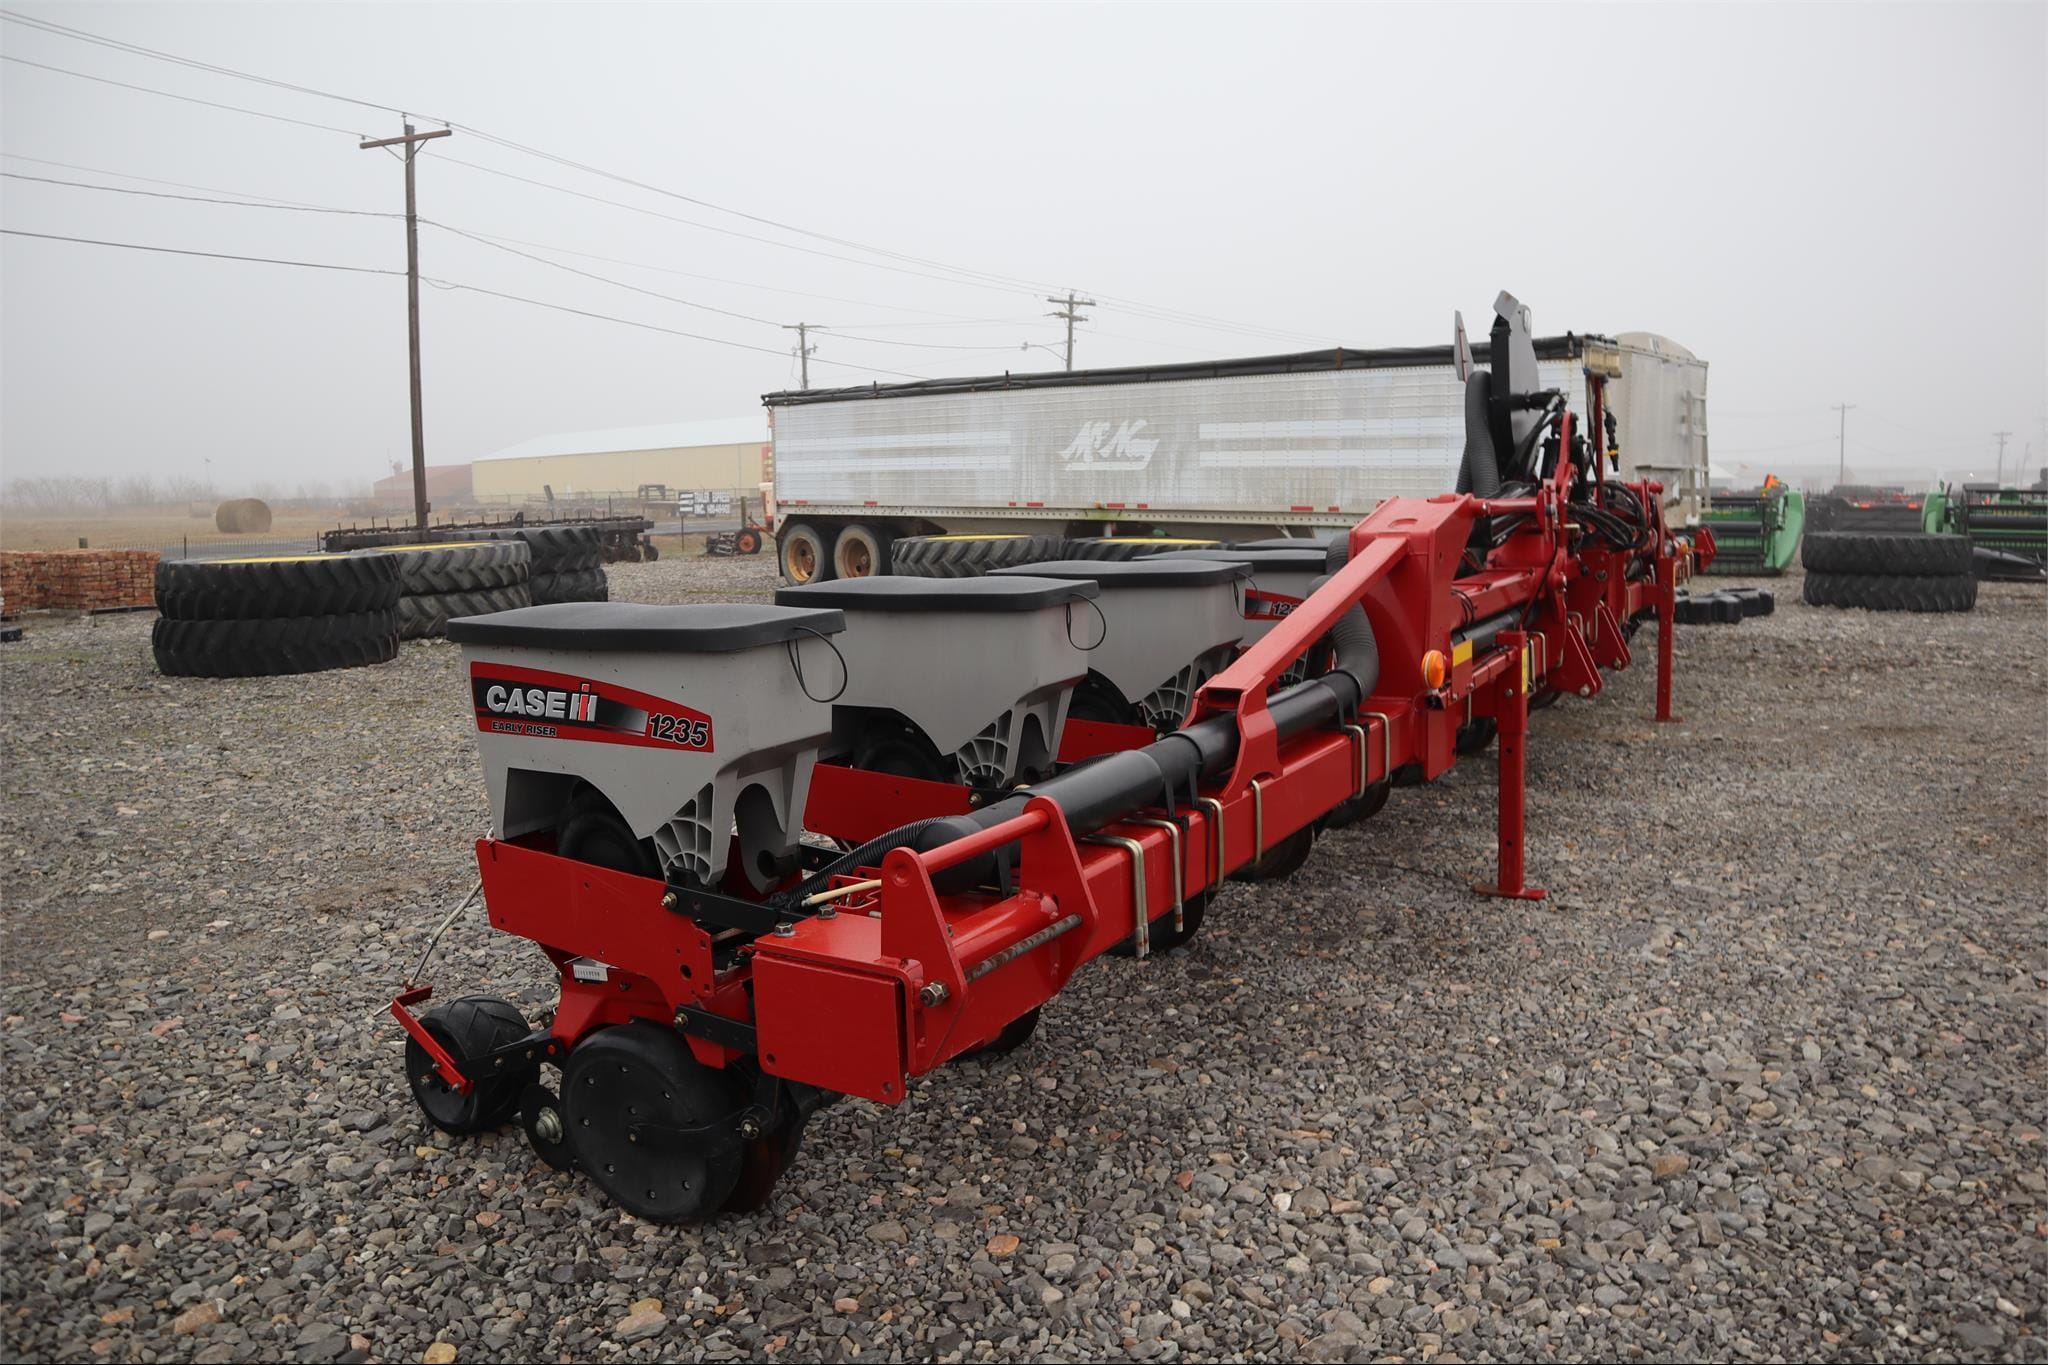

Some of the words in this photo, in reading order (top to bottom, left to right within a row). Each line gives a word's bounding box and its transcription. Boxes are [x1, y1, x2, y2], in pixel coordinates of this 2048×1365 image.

[1272, 601, 1300, 617] 12
[486, 685, 567, 719] CASE
[491, 720, 523, 733] EARLY
[525, 724, 558, 738] RISER
[649, 712, 709, 748] 1235
